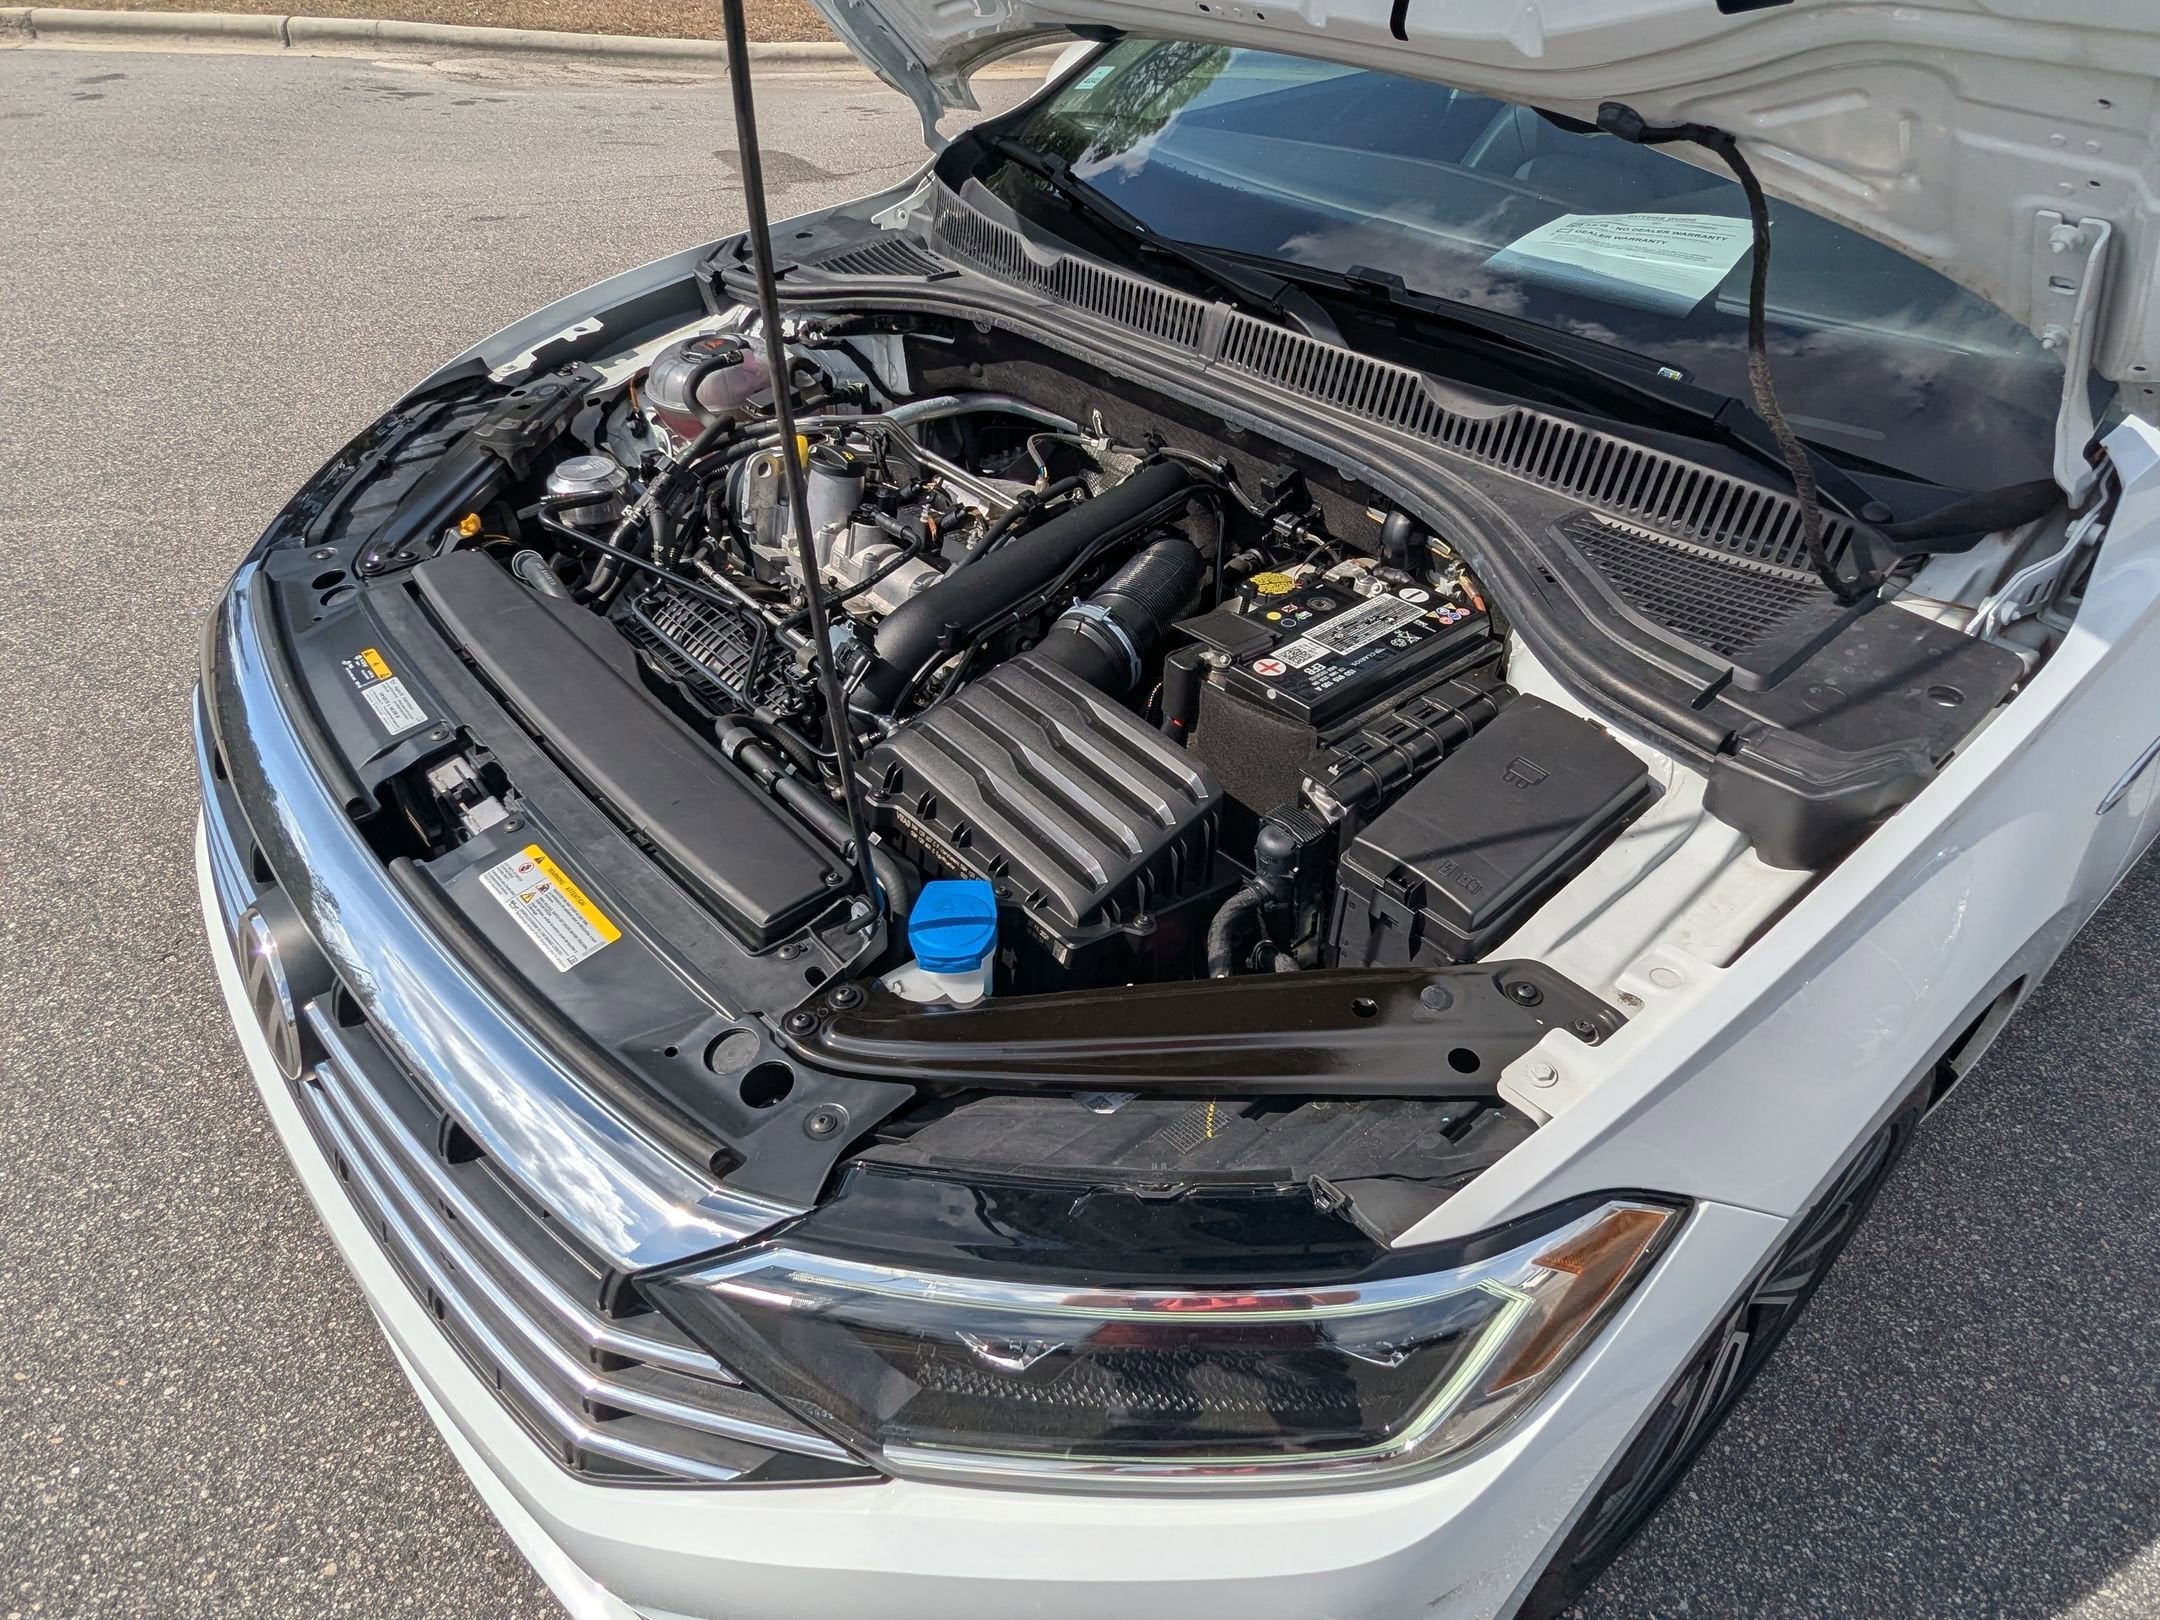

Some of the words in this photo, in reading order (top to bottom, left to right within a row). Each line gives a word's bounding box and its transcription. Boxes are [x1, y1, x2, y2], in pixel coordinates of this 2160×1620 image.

[1575, 229, 1613, 239] DEALER
[1613, 235, 1669, 245] WARRANTY
[1631, 227, 1671, 235] DEALER
[1672, 231, 1729, 241] WARRANTY
[1304, 663, 1326, 675] EFB
[547, 867, 567, 886] WARNING
[565, 886, 587, 907] ATTENTION
